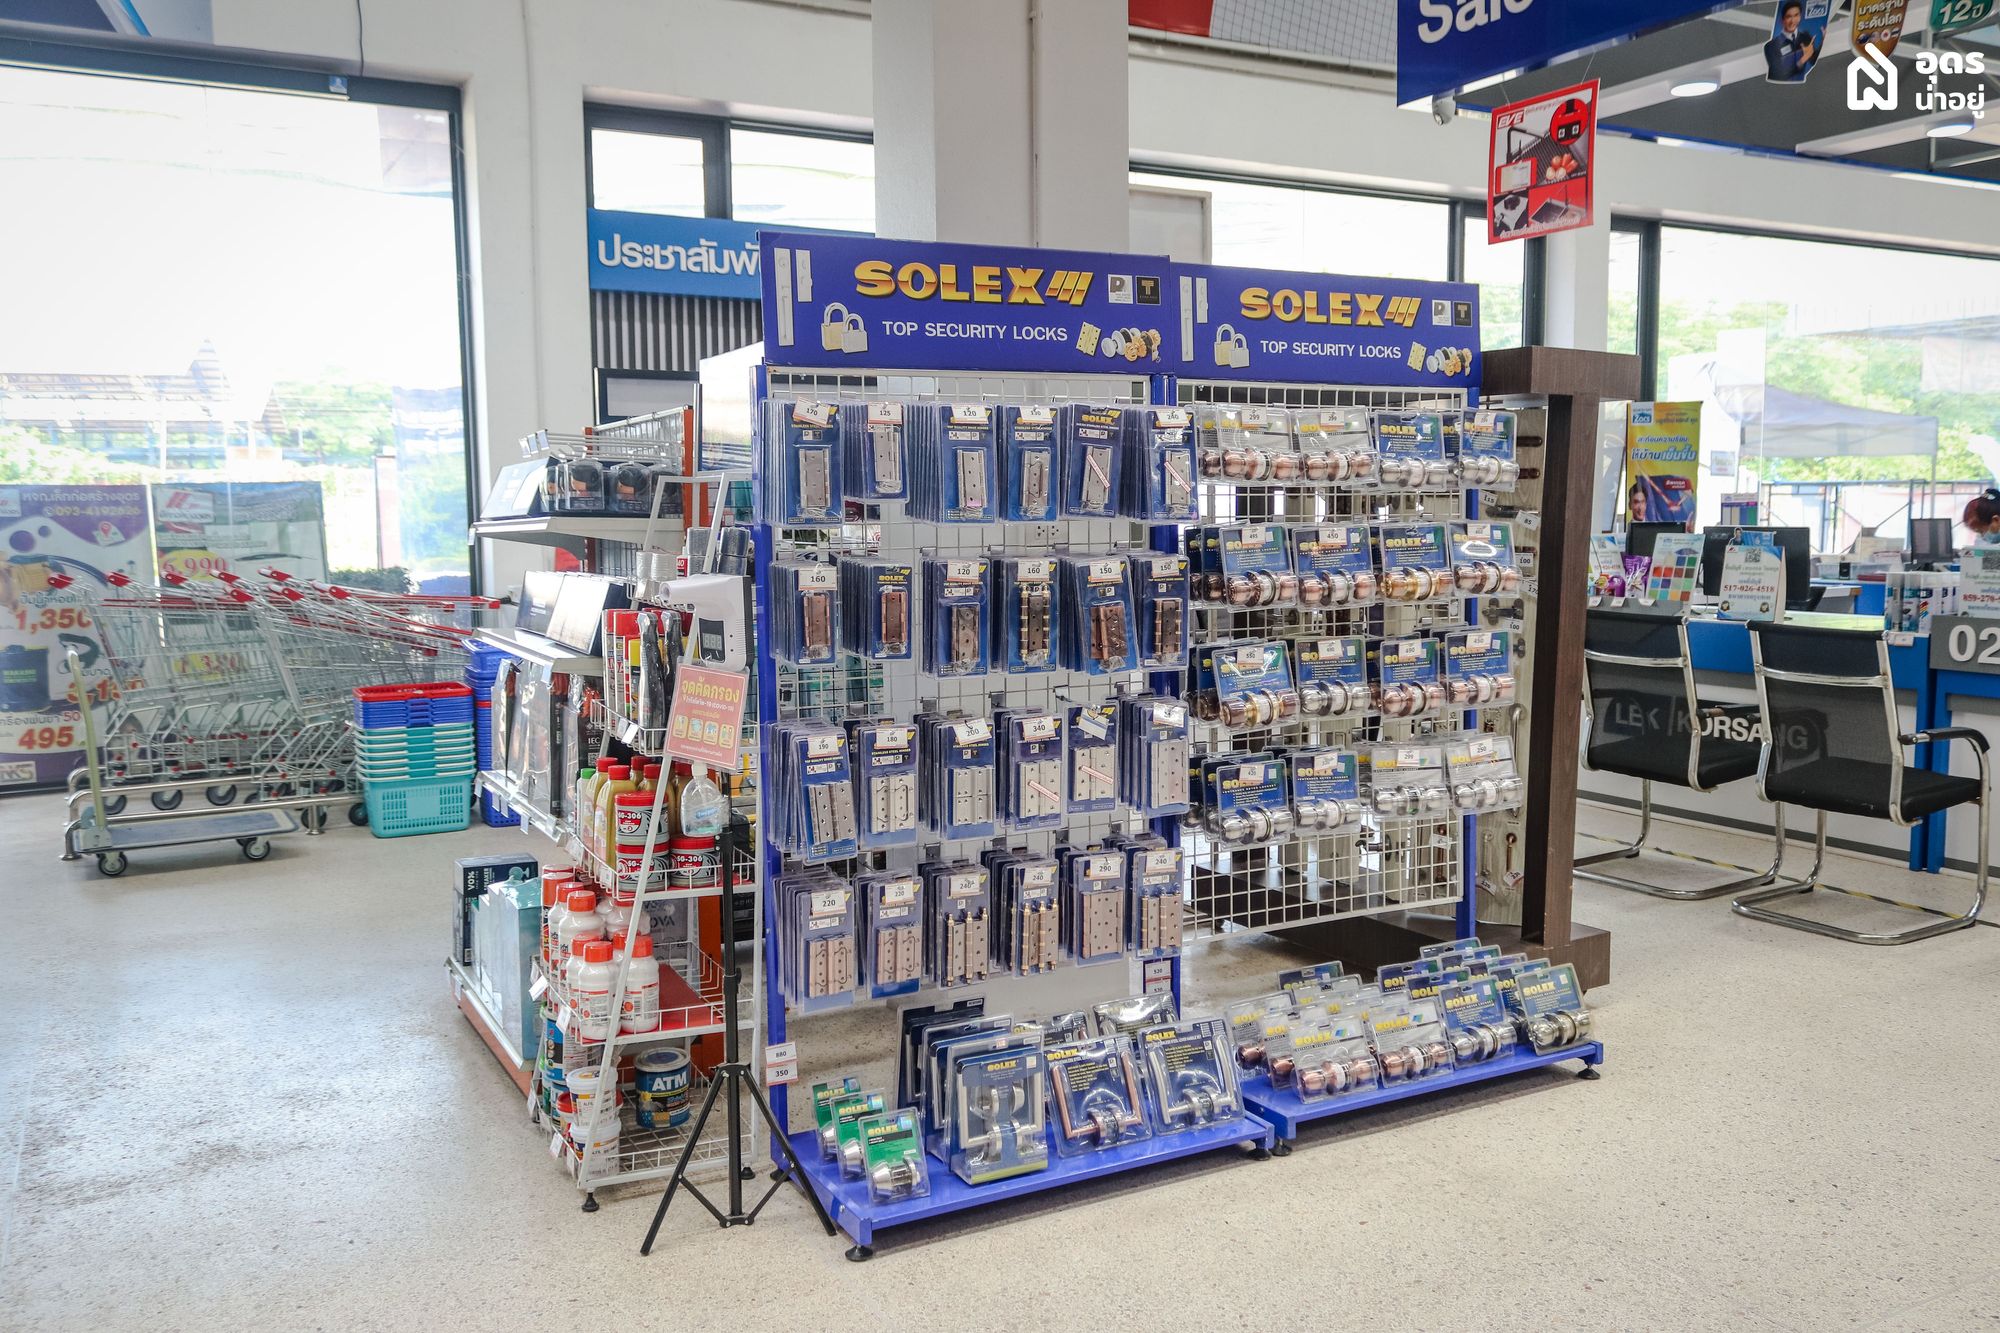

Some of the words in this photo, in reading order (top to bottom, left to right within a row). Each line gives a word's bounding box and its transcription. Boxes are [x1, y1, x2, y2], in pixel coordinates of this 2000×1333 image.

[854, 260, 1044, 305] SOLEX
[1239, 287, 1385, 327] SOLEX
[882, 321, 918, 338] TOP
[925, 322, 1007, 341] SECURITY
[1012, 324, 1068, 342] LOCKS
[1260, 340, 1288, 354] TOP
[1292, 341, 1355, 357] SECURITY
[1359, 345, 1401, 359] LOCKS
[806, 408, 818, 416] 170
[1082, 414, 1113, 424] SOLEX
[1380, 424, 1417, 435] SOLEX
[1386, 537, 1421, 548] SOLEX
[810, 575, 826, 583] 160
[1948, 624, 2000, 665] 02
[966, 728, 980, 736] 200
[1033, 723, 1046, 732] 340
[17, 725, 74, 750] 495
[822, 899, 836, 907] 220
[1384, 976, 1406, 988] SOL
[1495, 979, 1517, 991] SOL
[1411, 986, 1439, 999] SOLE
[1523, 982, 1556, 997] SOLEX
[1446, 994, 1479, 1009] SOLEX
[1375, 1016, 1409, 1032] SOLEX
[1145, 1030, 1176, 1041] SOLEX
[1295, 1031, 1332, 1046] SOLEX
[1047, 1049, 1078, 1061] SOLEX
[987, 1060, 1016, 1072] SOLEX
[775, 1069, 789, 1077] 350
[651, 1071, 687, 1091] ATM
[817, 1088, 845, 1099] SOLEX
[838, 1104, 868, 1115] SOLEX
[868, 1124, 898, 1136] SOLEX
